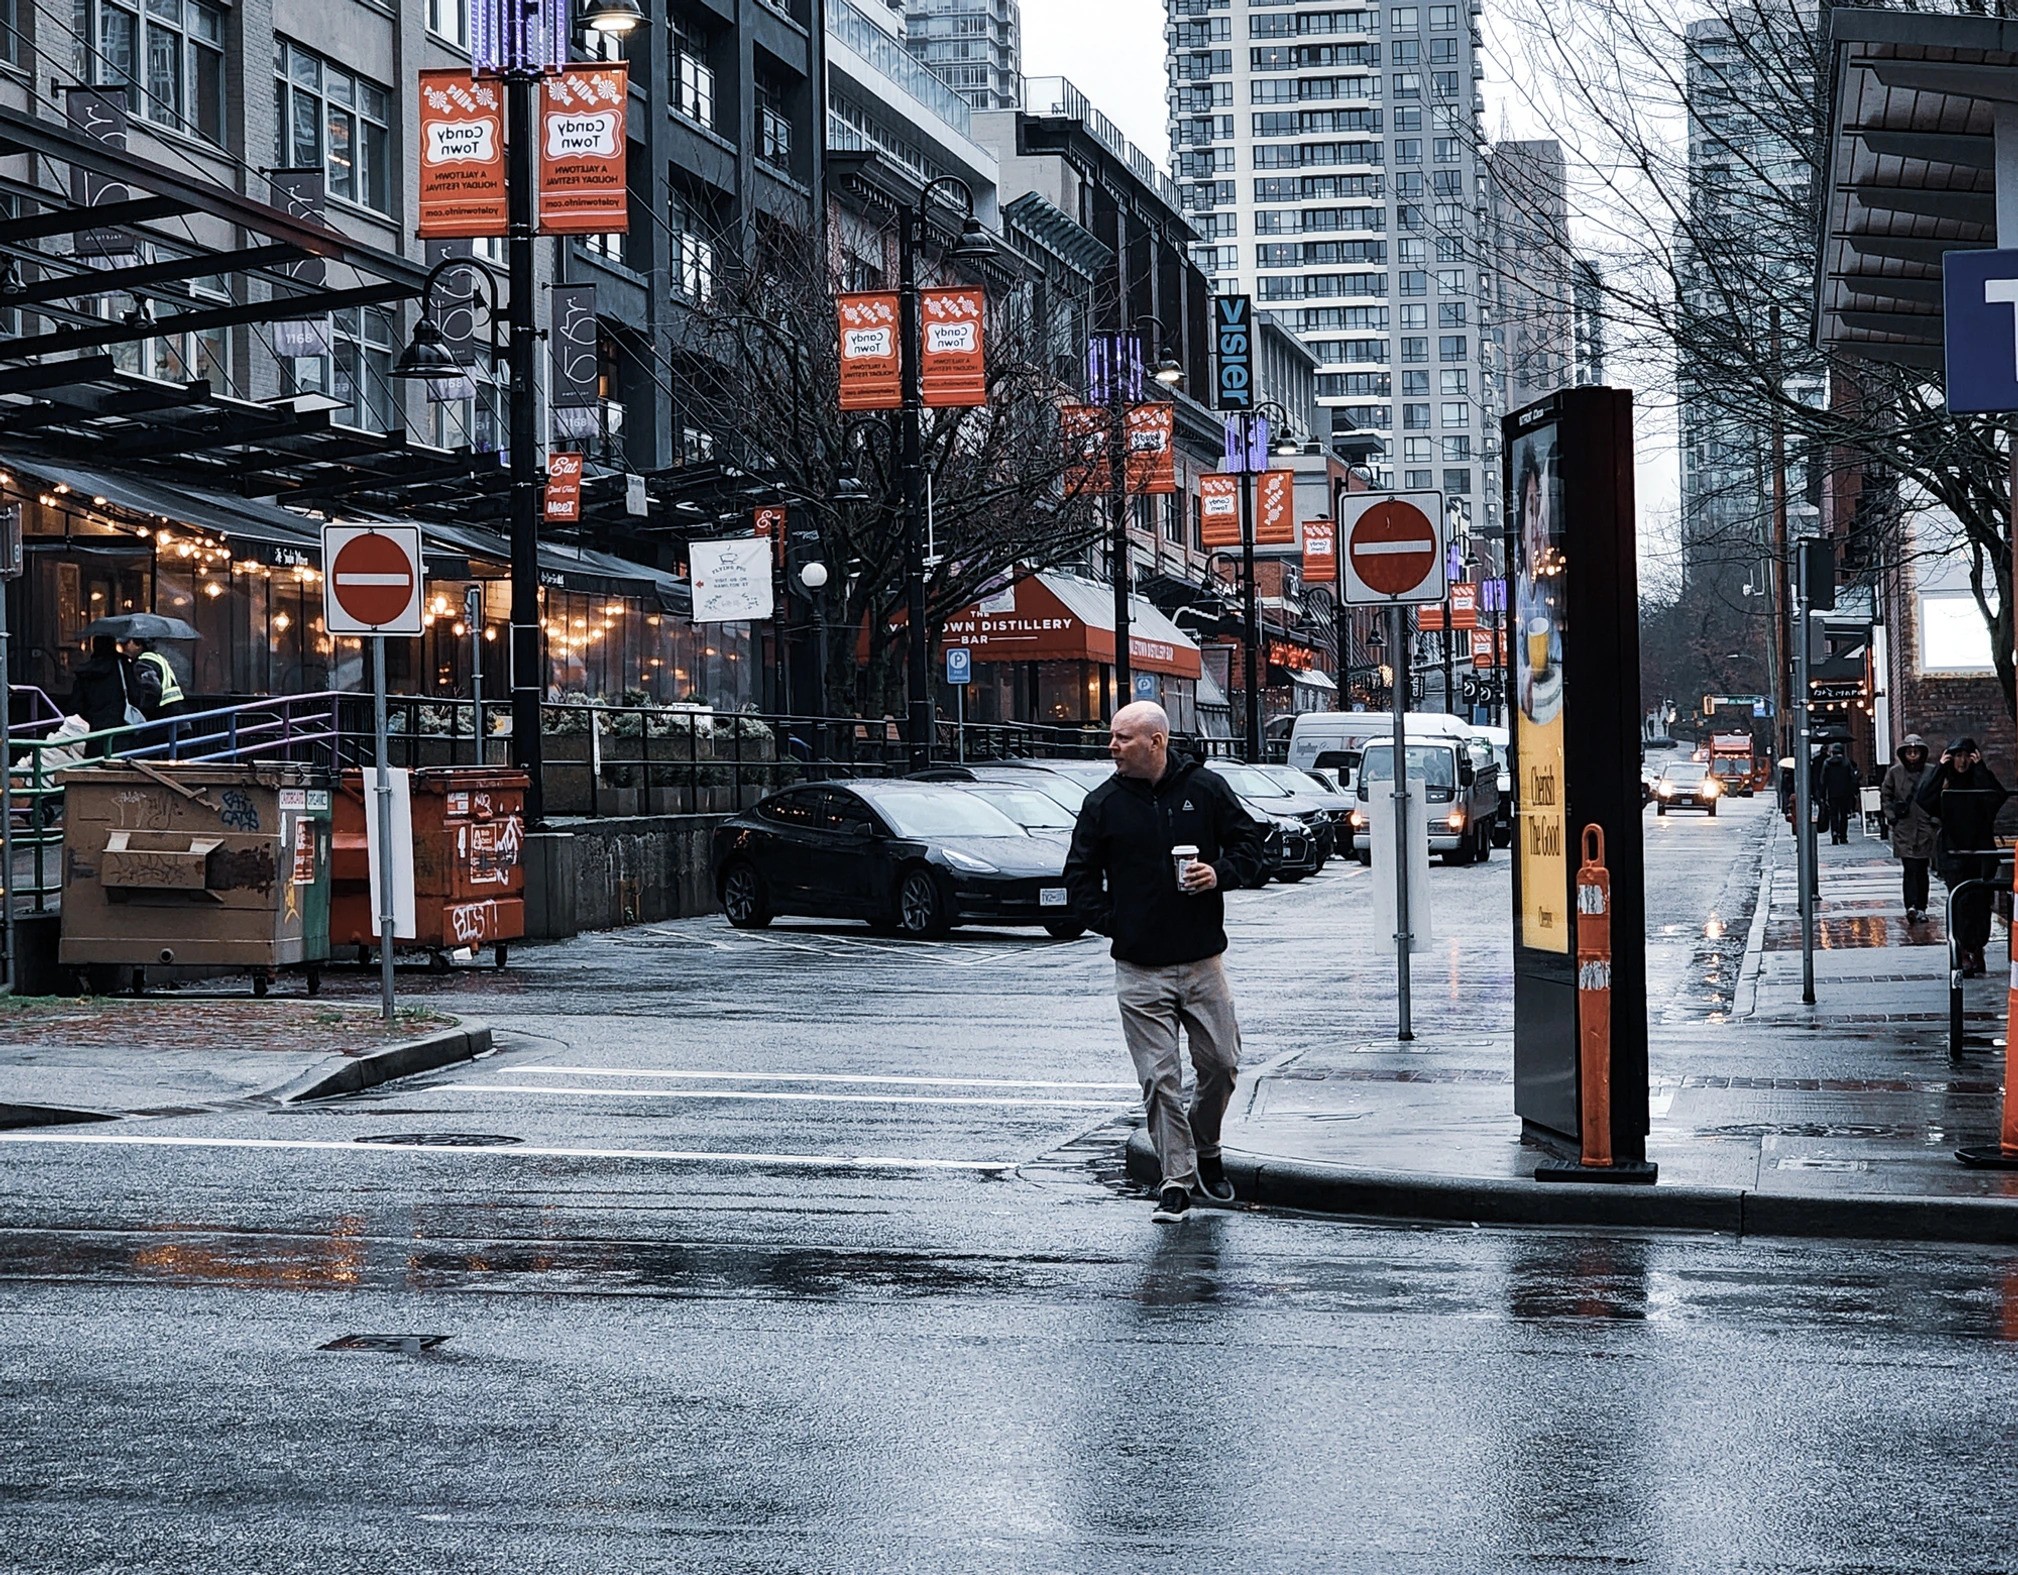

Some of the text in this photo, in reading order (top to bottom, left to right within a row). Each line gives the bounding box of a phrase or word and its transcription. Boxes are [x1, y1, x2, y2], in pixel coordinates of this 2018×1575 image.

[285, 333, 314, 345] 1168
[550, 456, 579, 477] Eat
[970, 610, 990, 618] THE
[982, 618, 1072, 631] DISTILLERY
[961, 635, 988, 644] BAR
[1531, 764, 1556, 806] Cherish
[1528, 815, 1560, 856] The Good
